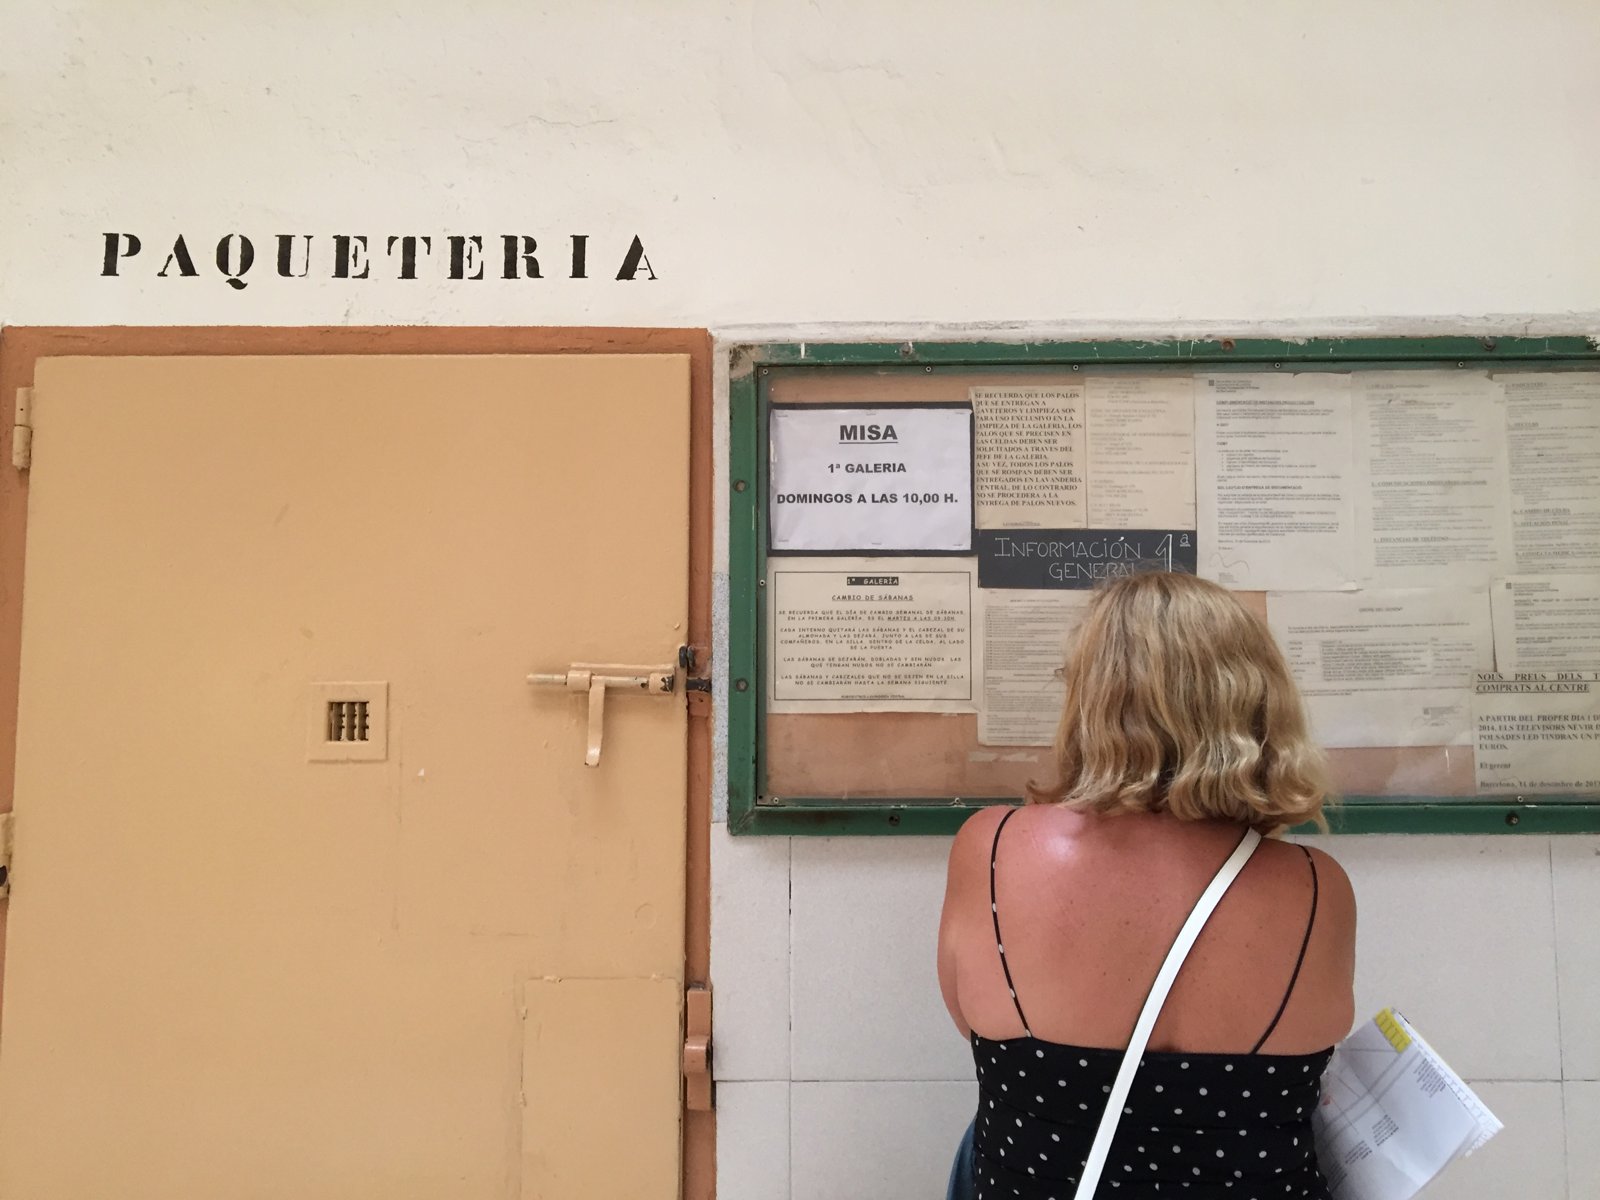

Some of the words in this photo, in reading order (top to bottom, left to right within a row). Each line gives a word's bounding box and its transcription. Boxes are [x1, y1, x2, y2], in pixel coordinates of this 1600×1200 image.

[100, 232, 658, 290] PAQUETERIA
[840, 425, 898, 441] MISA
[828, 464, 840, 473] 1ª
[845, 464, 906, 473] GALERIA
[777, 493, 852, 504] DOMINGOS
[858, 493, 866, 504] A
[872, 493, 897, 504] LAS
[903, 493, 939, 505] 10,00
[944, 493, 958, 504] H.
